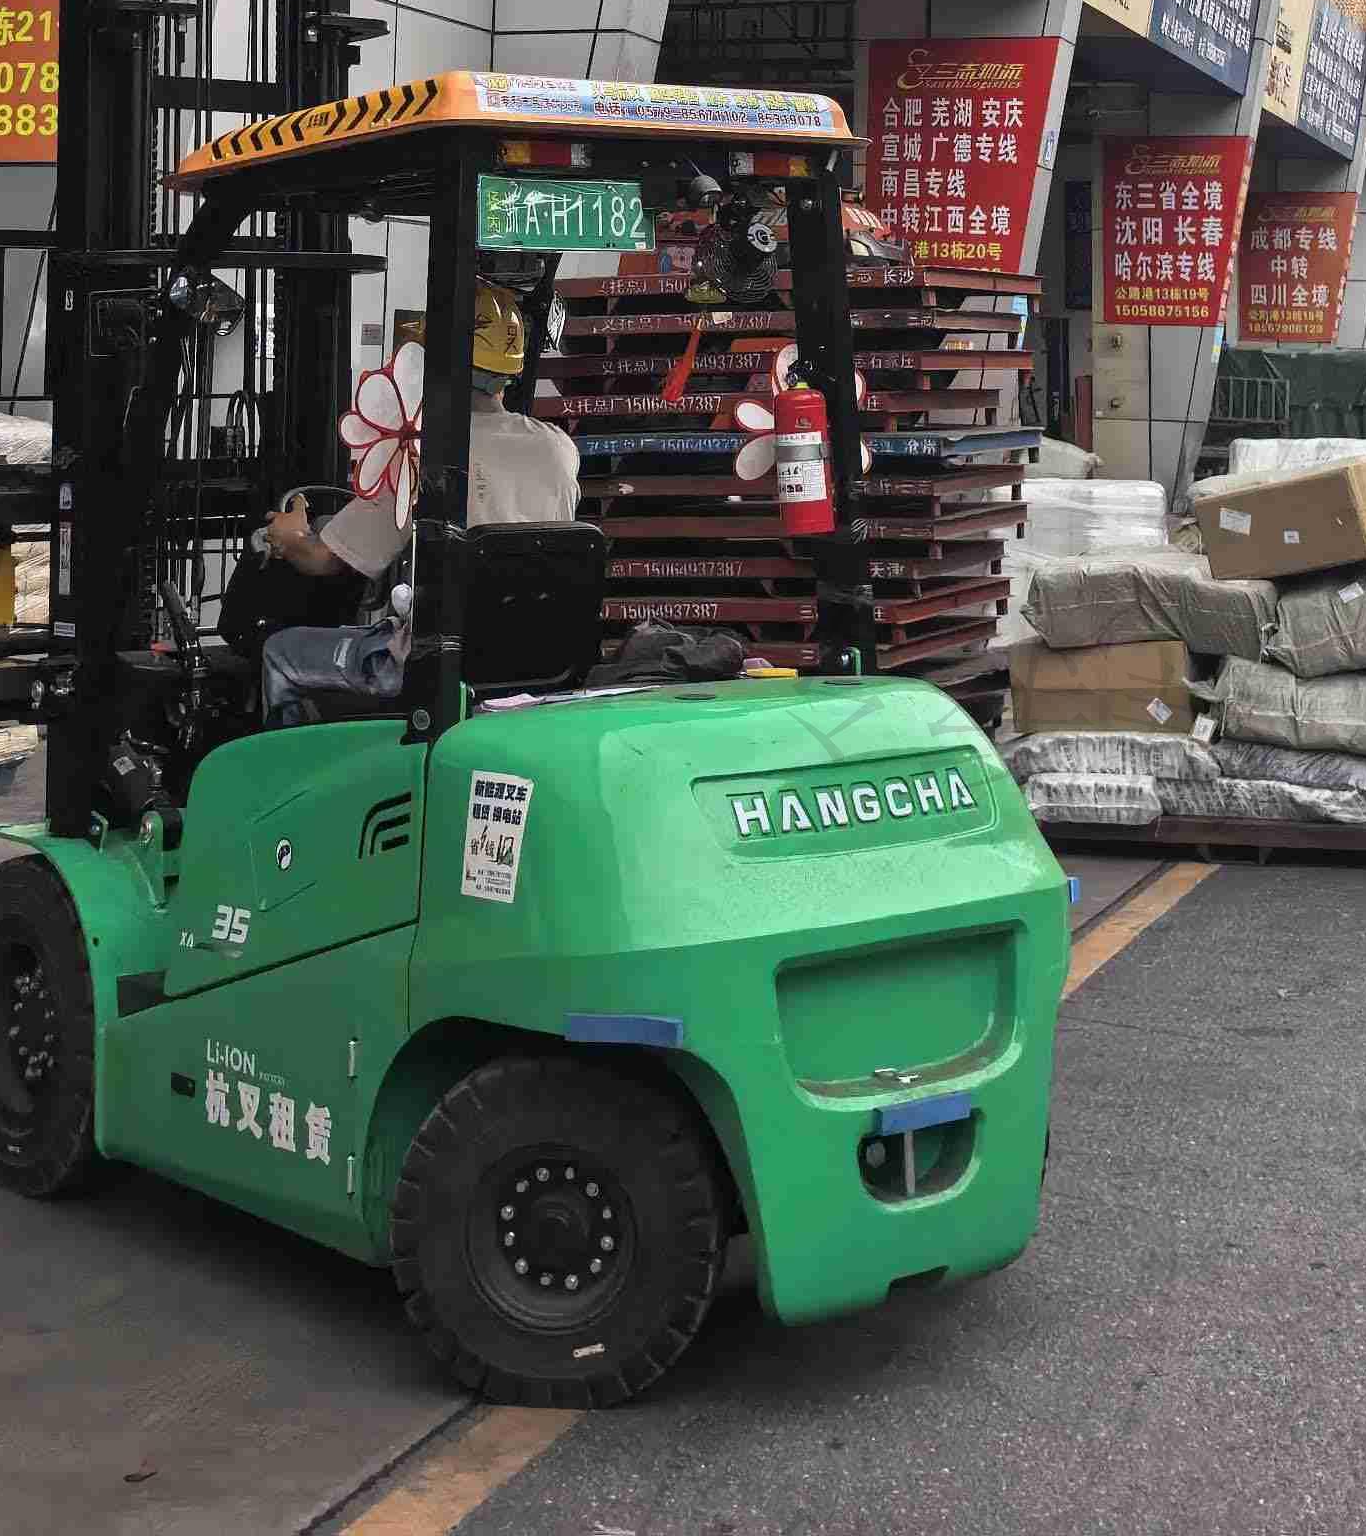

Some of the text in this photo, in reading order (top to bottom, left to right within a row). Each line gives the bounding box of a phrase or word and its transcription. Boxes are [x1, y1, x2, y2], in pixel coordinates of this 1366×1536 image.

[883, 97, 1024, 128] 合肥 芜湖 安庆
[881, 133, 923, 163] 宣城
[931, 133, 1019, 165] 广德专线
[880, 167, 967, 200] 南昌专线
[1115, 181, 1224, 211] 东三省全境
[880, 204, 1012, 237] 中转江西全境
[1115, 215, 1224, 247] 沈阳 长春
[1250, 226, 1338, 251] 成都专线
[884, 268, 915, 284] 长沙
[1114, 250, 1217, 282] 哈尔滨专线
[1250, 284, 1331, 308] 四川全境
[733, 766, 975, 837] HANGCHA
[211, 903, 252, 945] 35
[204, 1068, 333, 1166] 杭叉租赁
